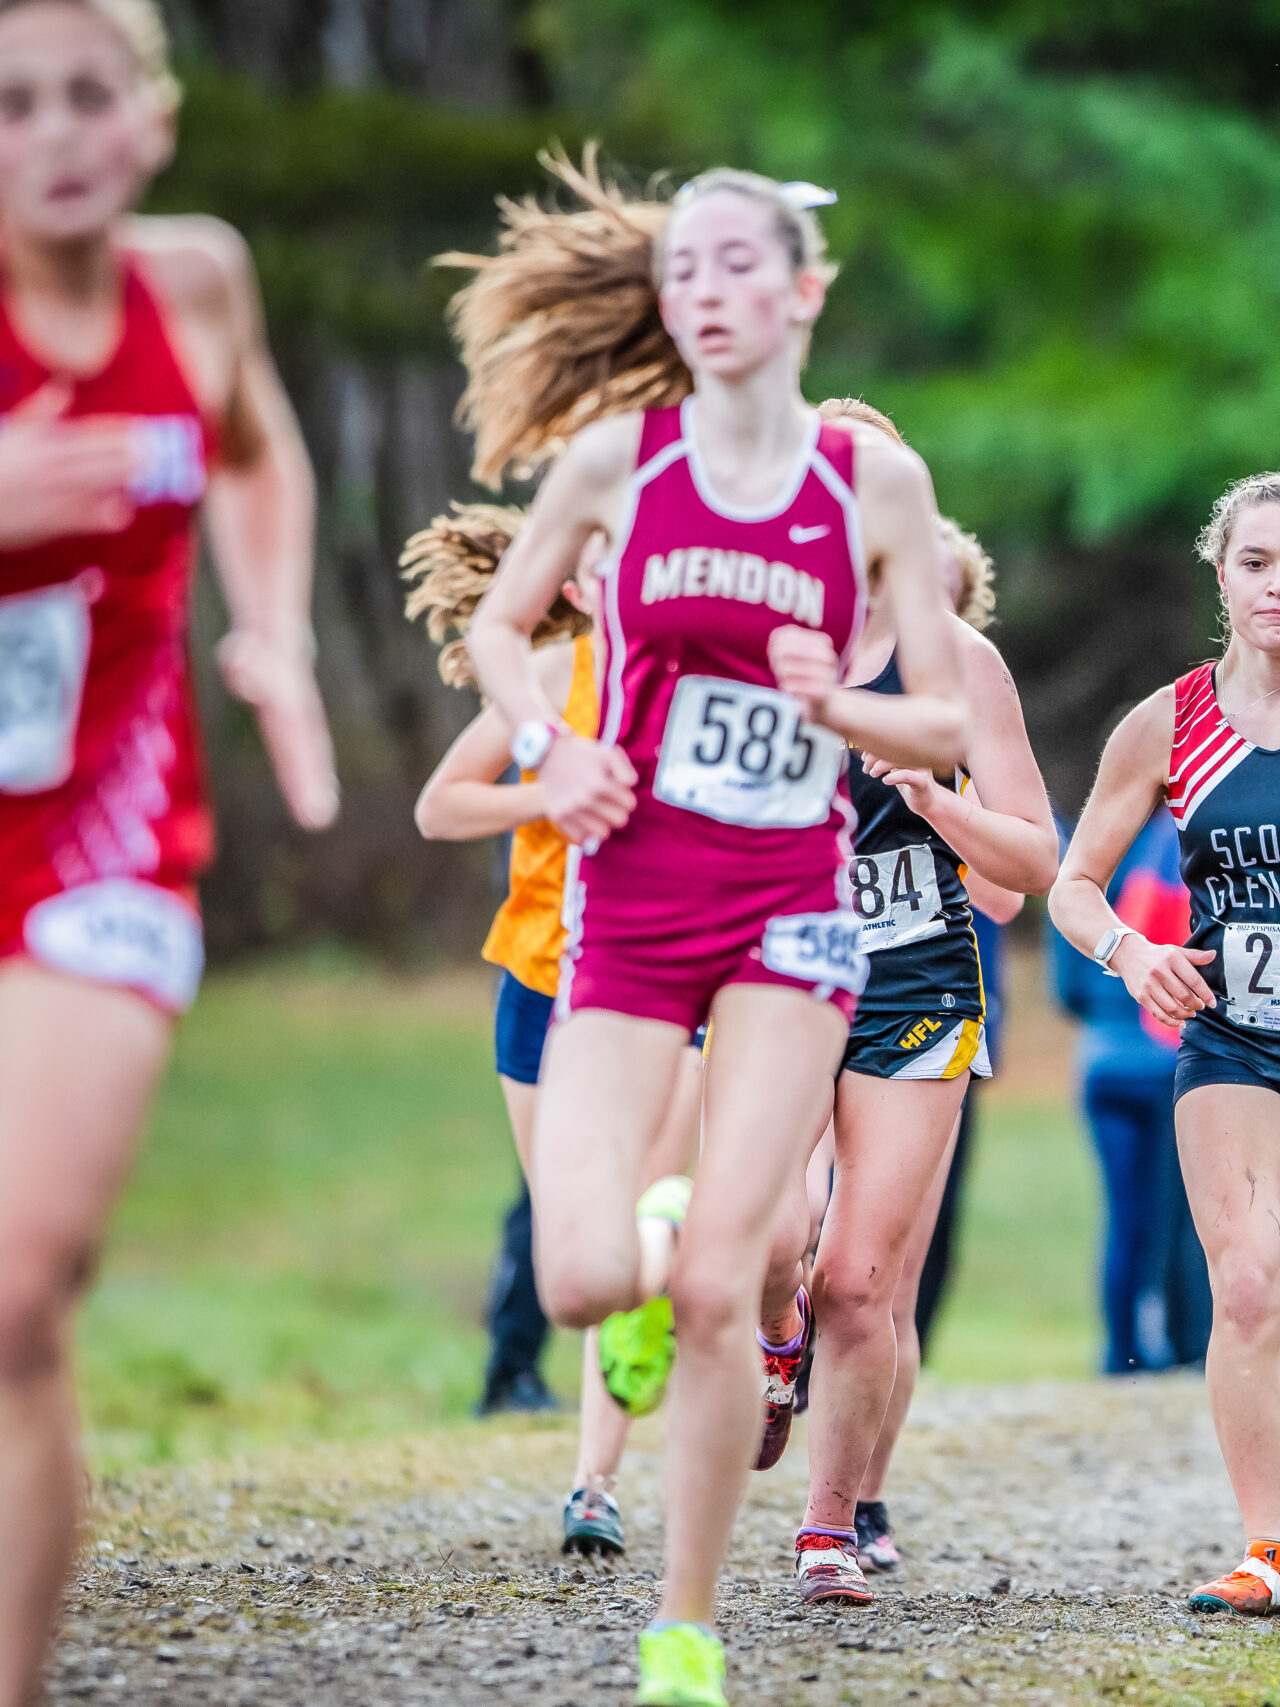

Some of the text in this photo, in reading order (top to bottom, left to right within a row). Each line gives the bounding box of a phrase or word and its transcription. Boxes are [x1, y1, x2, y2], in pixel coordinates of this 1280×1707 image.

[640, 546, 826, 629] MENDON
[693, 695, 815, 782] 585
[862, 920, 897, 931] ATHLETIC
[1236, 924, 1250, 932] 2022
[900, 1017, 942, 1049] HFL
